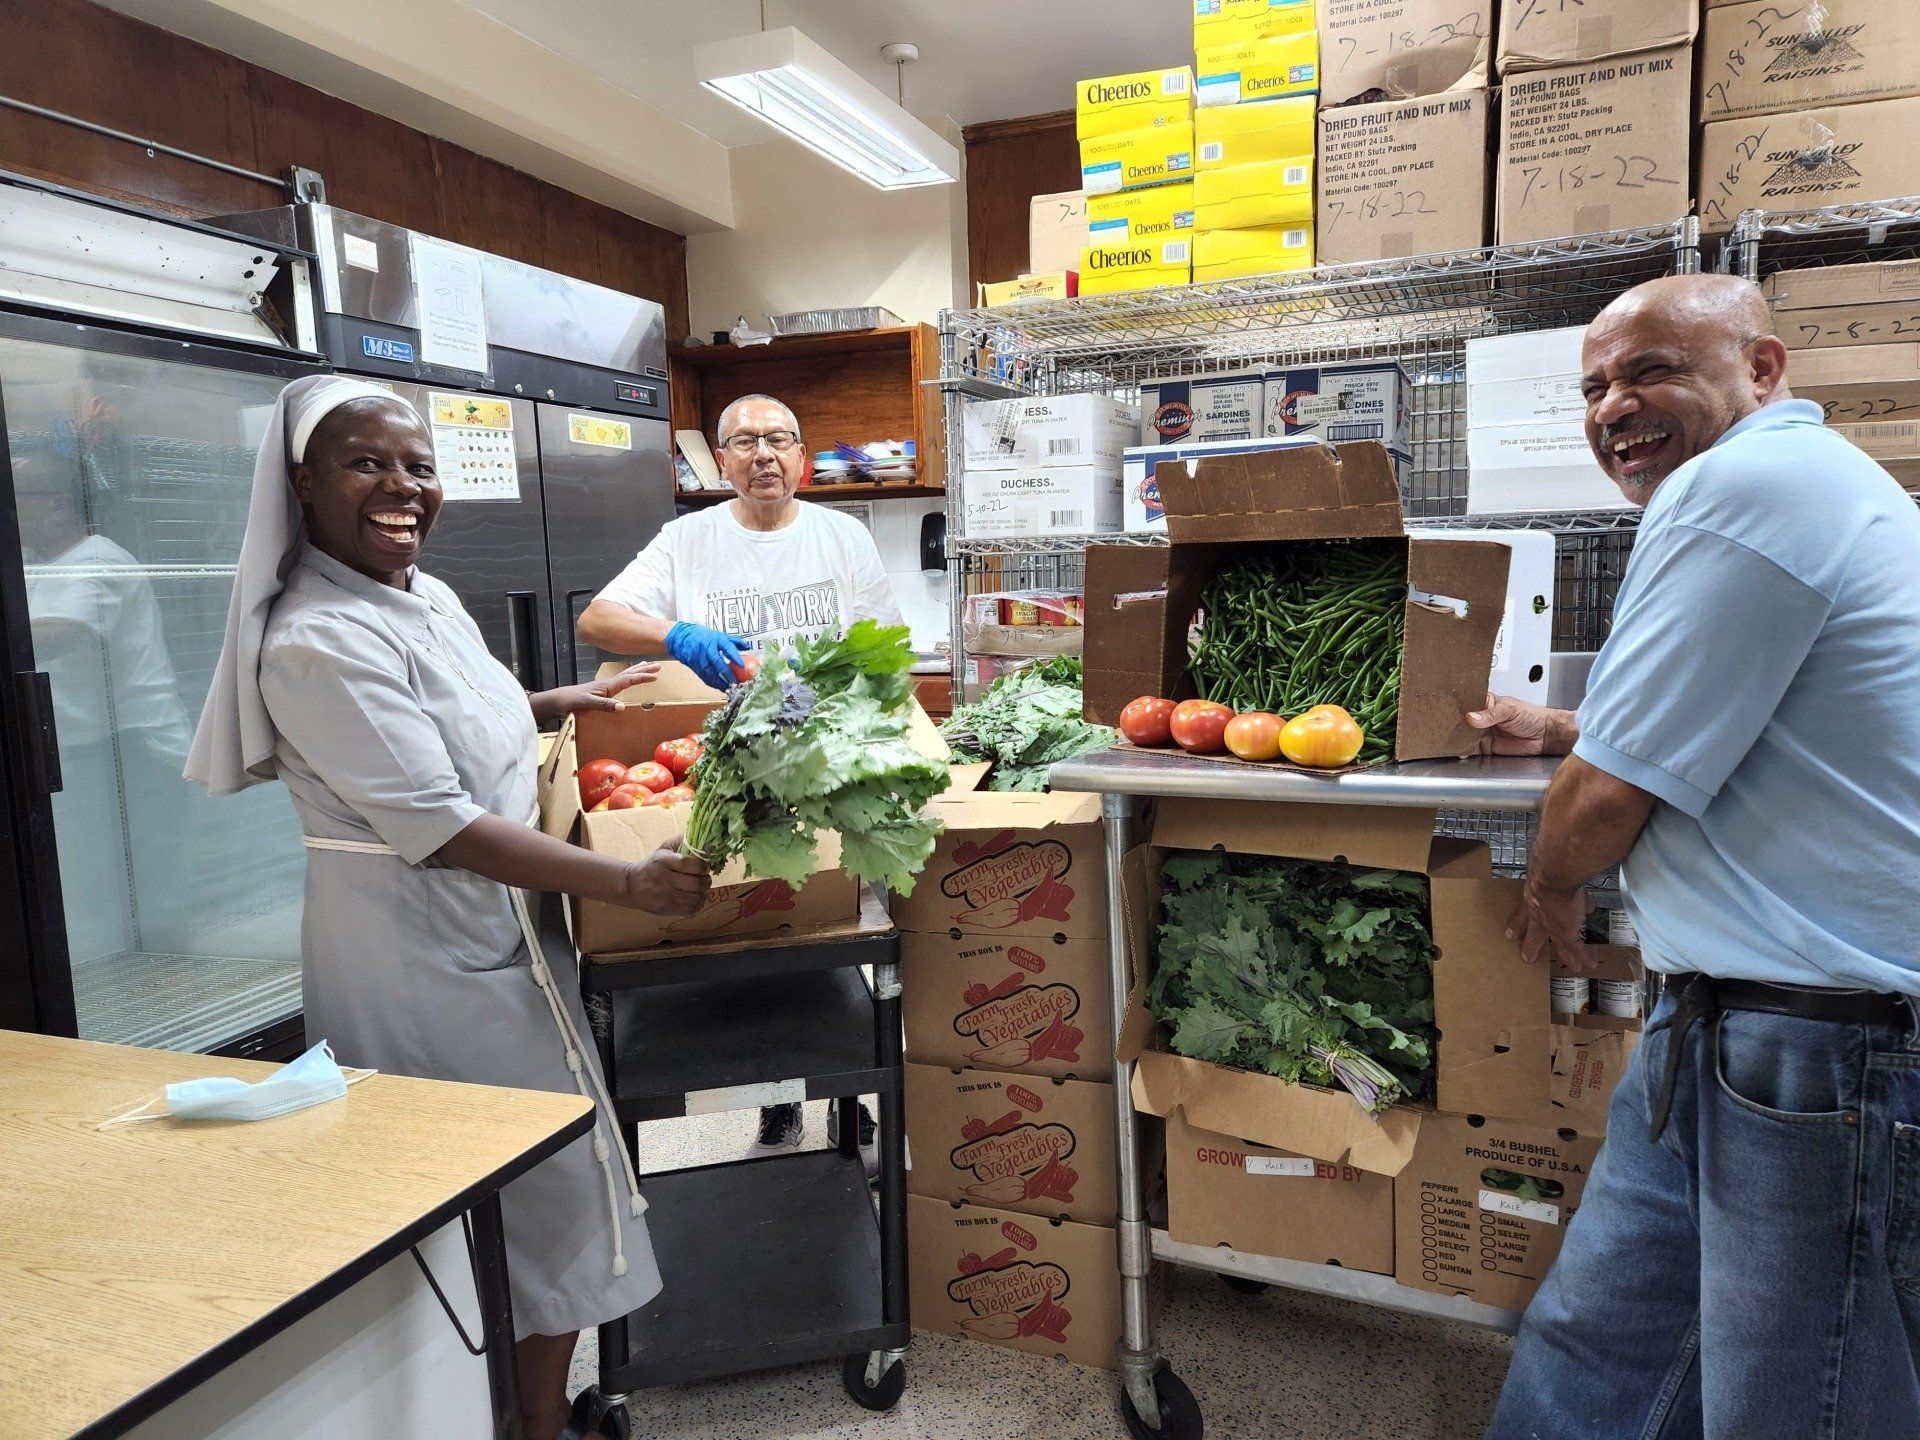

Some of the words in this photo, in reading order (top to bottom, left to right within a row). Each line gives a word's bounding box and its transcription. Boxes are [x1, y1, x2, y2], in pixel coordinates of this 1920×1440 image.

[1330, 4, 1354, 15] STORE
[1330, 18, 1356, 29] Material
[1359, 15, 1378, 23] Code:
[1765, 34, 1801, 47] SUN
[1248, 76, 1284, 91] Cheerios
[1510, 80, 1546, 97] DRIED
[1550, 73, 1586, 89] FRUIT
[1589, 68, 1615, 83] AND
[1620, 63, 1645, 78] NUT
[1649, 58, 1674, 73] MIX
[1088, 81, 1151, 104] Cheerios
[1510, 96, 1527, 106] 24/1
[1530, 92, 1557, 103] POUND
[1559, 88, 1580, 98] BAGS
[1326, 118, 1357, 132] DRIED
[1362, 111, 1393, 126] FRUIT
[1395, 107, 1419, 121] AND
[1423, 103, 1446, 116] NUT
[1450, 99, 1472, 112] MIX
[1510, 108, 1524, 118] NET
[1527, 103, 1557, 115] WEIGHT
[1559, 101, 1569, 110] 24
[1571, 98, 1589, 108] LBS.
[1510, 117, 1540, 129] PACKED
[1543, 114, 1556, 124] BY:
[1558, 111, 1578, 121] Stutz
[1580, 106, 1613, 118] Packing
[1326, 133, 1341, 142] 24/1
[1343, 128, 1366, 139] POUND
[1369, 125, 1388, 134] BAGS
[1510, 140, 1536, 151] STORE
[1539, 137, 1547, 146] IN
[1550, 136, 1556, 144] A
[1558, 133, 1583, 143] COOL,
[1585, 129, 1602, 139] DRY
[1605, 124, 1633, 135] PLACE
[1534, 128, 1545, 136] CA
[1547, 124, 1570, 135] 92201
[1326, 143, 1339, 153] NET
[1340, 139, 1367, 150] WEIGHT
[1369, 137, 1378, 146] 24
[1380, 135, 1396, 144] LBS.
[1326, 152, 1352, 163] PACKED
[1355, 150, 1366, 159] BY:
[1368, 147, 1385, 157] Stutz
[1388, 143, 1417, 154] Packing
[1510, 154, 1540, 164] Material
[1541, 150, 1562, 160] Code:
[1564, 145, 1591, 156] 100297
[1764, 150, 1798, 162] SUN
[1128, 164, 1164, 178] Cheerios
[1325, 173, 1349, 184] STORE
[1351, 172, 1359, 180] IN
[1360, 170, 1366, 178] A
[1368, 168, 1390, 178] COOL,
[1392, 164, 1408, 174] DRY
[1410, 160, 1435, 172] PLACE
[1347, 162, 1356, 170] CA
[1358, 159, 1379, 169] 92201
[1325, 187, 1352, 197] Material
[1353, 184, 1372, 192] Code:
[1135, 221, 1170, 236] Cheerios
[1090, 248, 1151, 269] Cheerios
[367, 339, 392, 356] M3
[1024, 407, 1048, 416] HESS
[1355, 400, 1384, 408] DINES
[1147, 411, 1203, 431] Premium
[1206, 410, 1250, 420] SARDINES
[1001, 478, 1050, 489] DUCHESS
[707, 595, 760, 634] NEW
[774, 587, 836, 630] YORK
[950, 861, 991, 894] Farm
[990, 848, 1029, 882] Fresh
[972, 848, 1064, 904] Vegetables
[958, 950, 976, 958] THIS
[978, 947, 994, 955] BOX
[962, 1003, 1001, 1032] Farm
[1000, 991, 1039, 1024] Fresh
[983, 991, 1072, 1043] Vegetables
[957, 1085, 974, 1093] THIS
[976, 1082, 992, 1090] BOX
[959, 1140, 997, 1166] Farm
[996, 1129, 1035, 1161] Fresh
[979, 1130, 1068, 1178] Vegetables
[1489, 1138, 1506, 1149] 3/4
[1510, 1141, 1560, 1158] BUSHEL
[1196, 1148, 1244, 1168] GROW
[1316, 1164, 1338, 1179] ED
[1342, 1166, 1364, 1182] BY
[1465, 1147, 1524, 1165] PRODUCE
[1528, 1157, 1544, 1167] OF
[1548, 1160, 1586, 1175] U.S.A.
[1421, 1181, 1459, 1194] PEPPERS
[1437, 1195, 1474, 1209] X-LARGE
[1500, 1200, 1523, 1212] KALE
[1438, 1207, 1466, 1218] LARGE
[955, 1219, 972, 1227] THIS
[974, 1218, 988, 1226] BOX
[1438, 1219, 1470, 1230] MEDIUM
[1497, 1218, 1526, 1229] SMALL
[1438, 1229, 1466, 1240] SMALL
[1497, 1229, 1531, 1242] SELECT
[1439, 1240, 1470, 1253] SELECT
[1498, 1240, 1528, 1252] LARGE
[1439, 1252, 1456, 1261] RED
[1498, 1252, 1524, 1264] PLAIN
[1439, 1263, 1472, 1275] SUNTAN
[955, 1276, 993, 1300] Farm
[993, 1266, 1029, 1298] Fresh
[974, 1270, 1062, 1314] Vegetables
